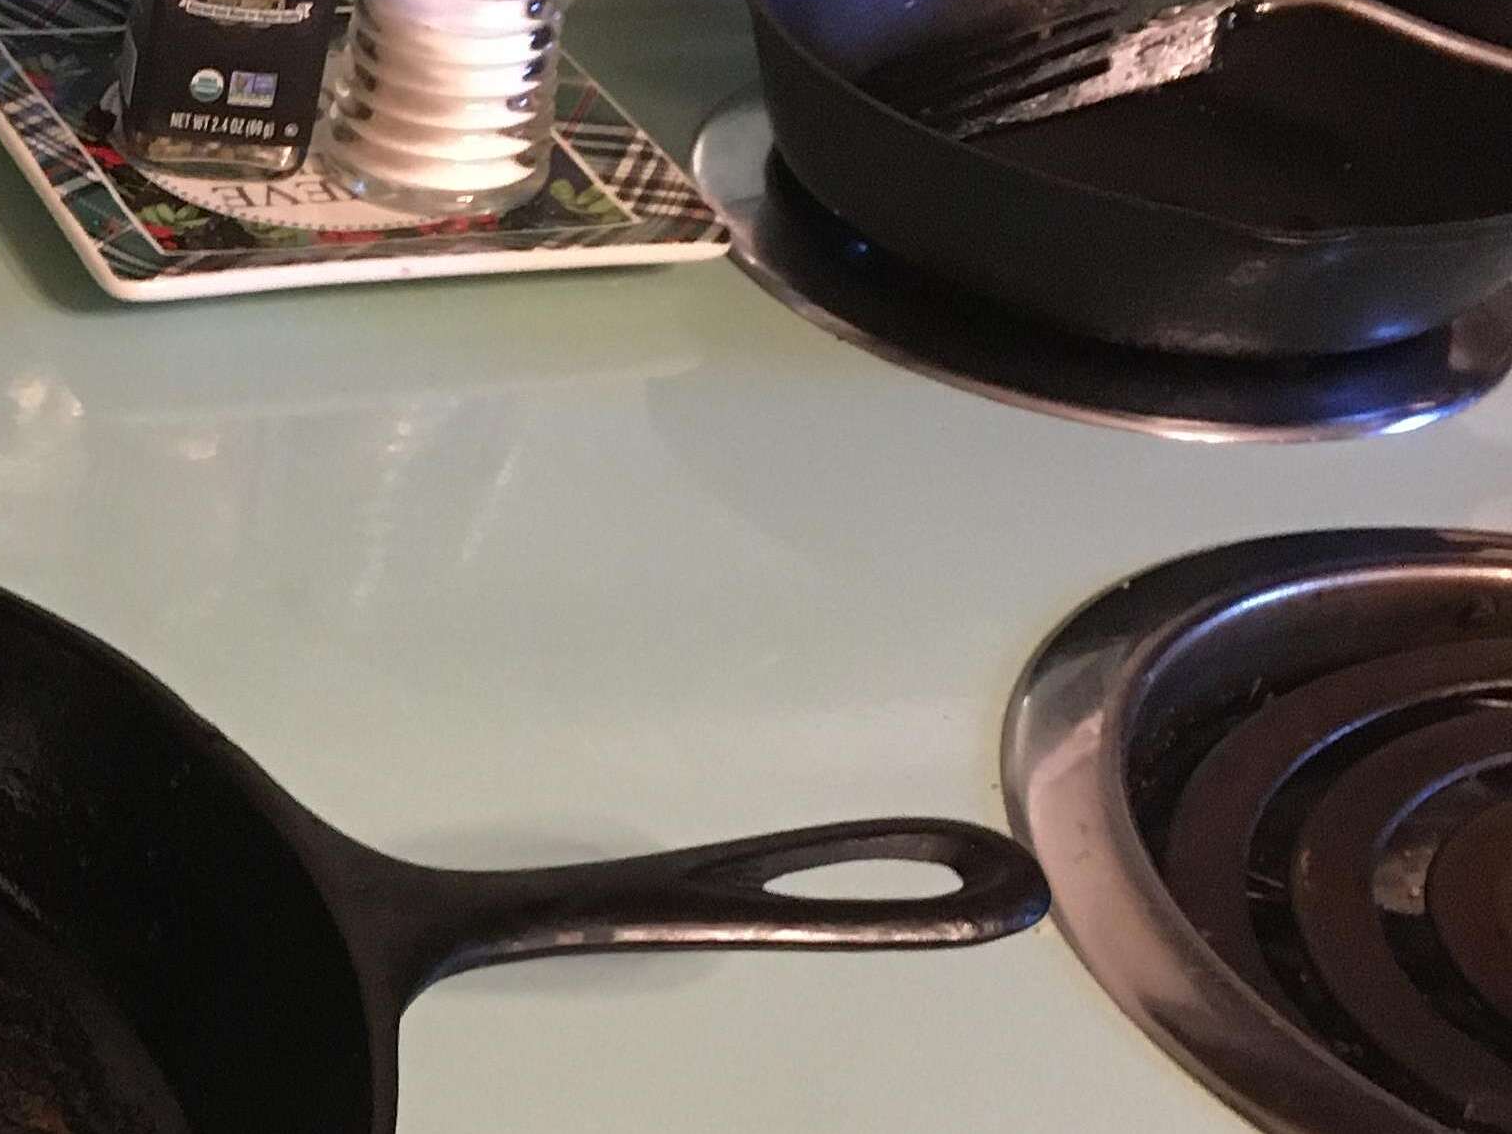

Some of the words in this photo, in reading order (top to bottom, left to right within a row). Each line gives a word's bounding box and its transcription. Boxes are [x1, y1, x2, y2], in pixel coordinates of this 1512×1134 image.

[170, 112, 191, 129] NET
[192, 114, 211, 131] WT
[210, 116, 228, 134] 2.4
[229, 118, 246, 135] OZ
